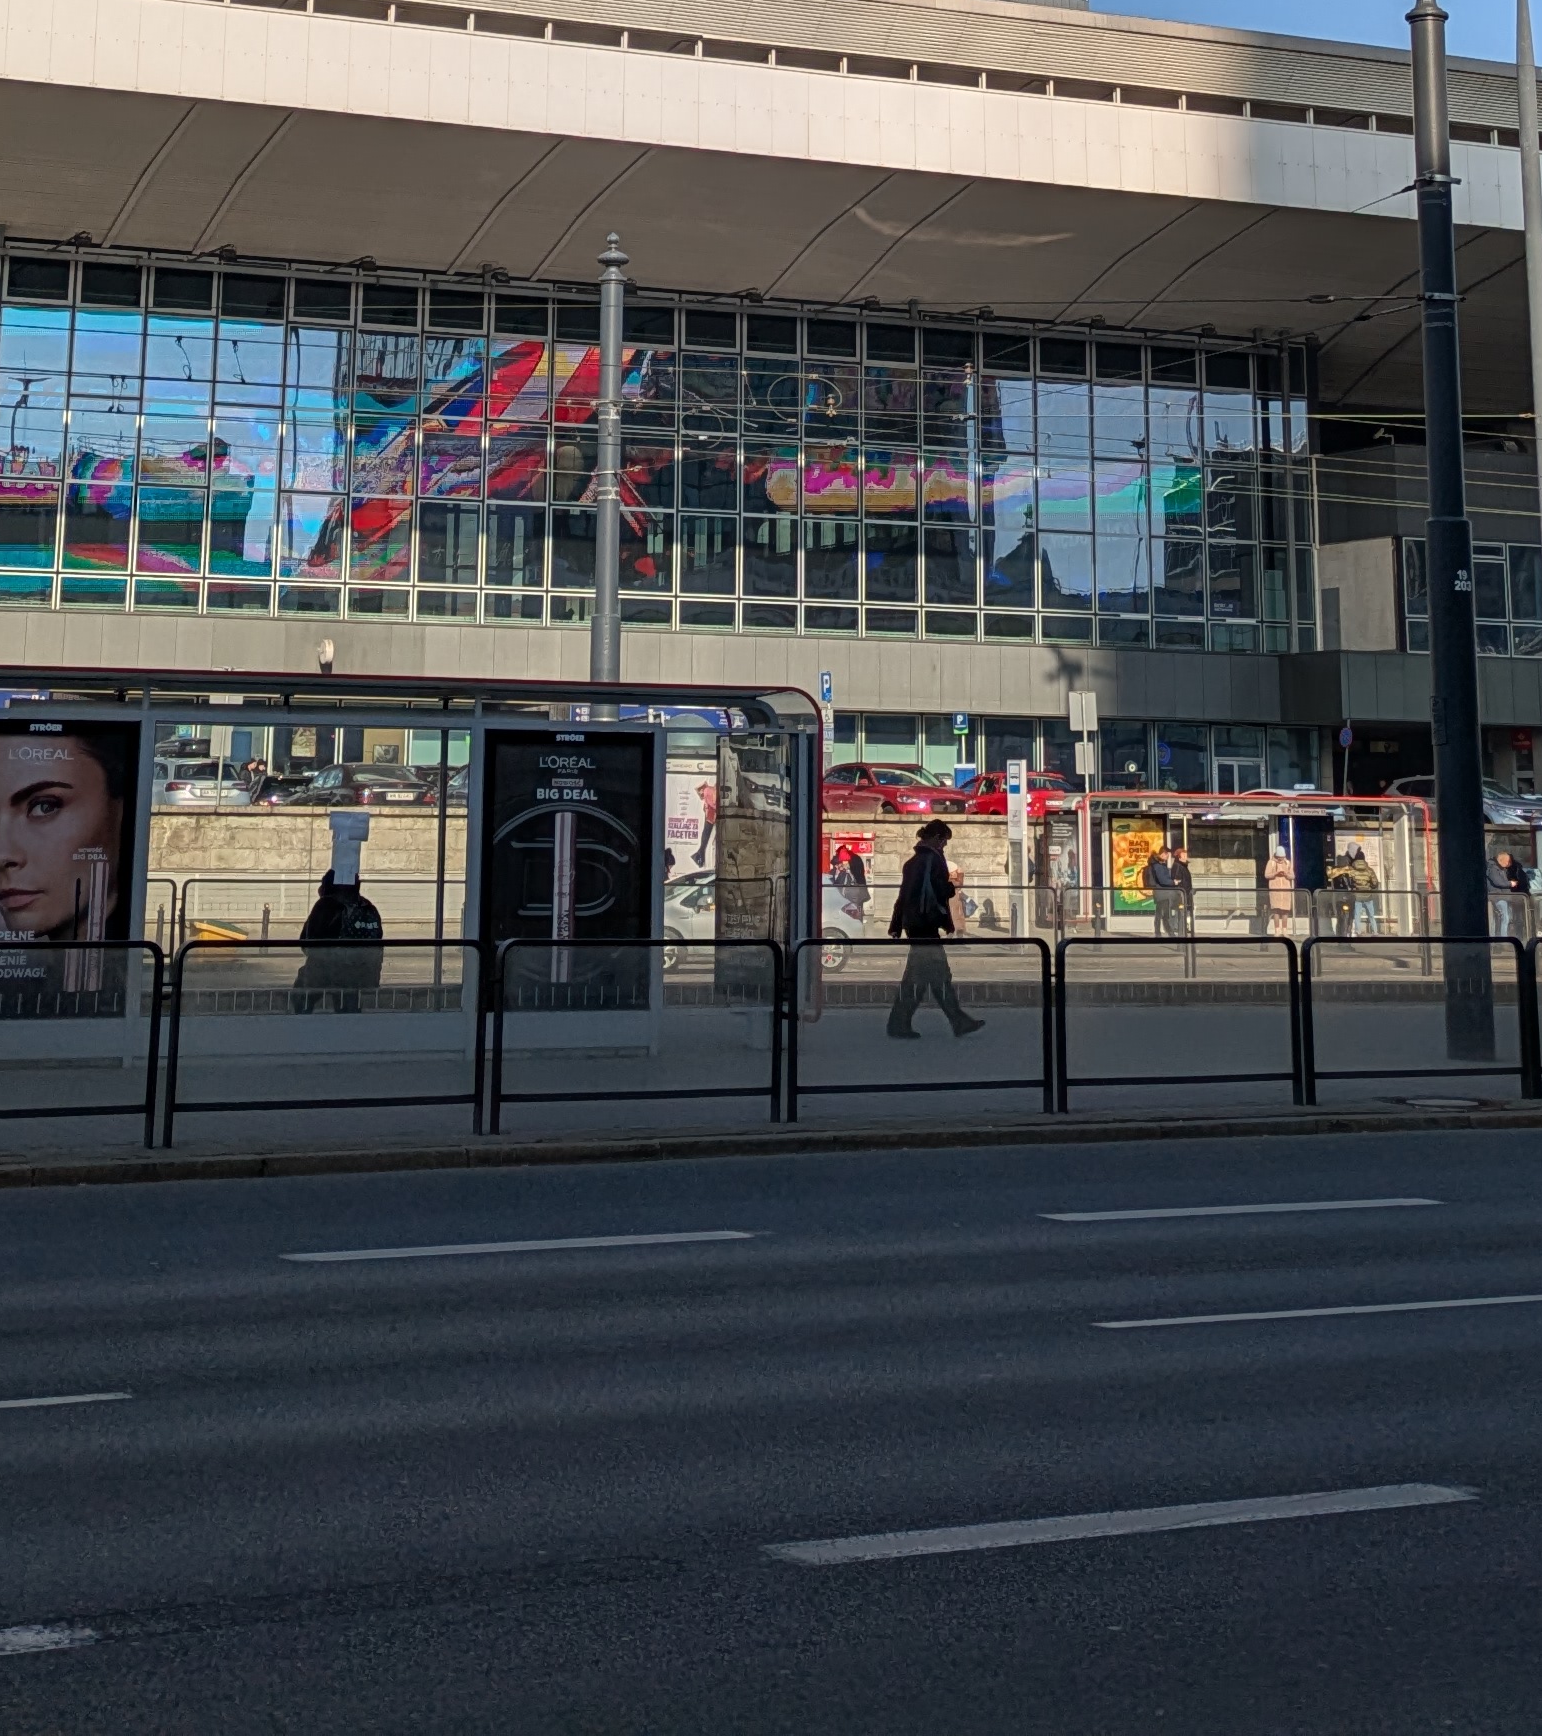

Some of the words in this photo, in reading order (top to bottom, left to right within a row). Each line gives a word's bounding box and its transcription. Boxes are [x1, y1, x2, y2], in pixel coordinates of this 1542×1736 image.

[1457, 569, 1468, 580] 19
[1454, 580, 1472, 591] 203
[823, 674, 831, 694] P
[956, 714, 964, 725] P
[29, 723, 63, 732] STRÖER
[539, 755, 596, 769] L'ORÉAL
[536, 788, 560, 800] BIG
[563, 789, 598, 801] DEAL
[667, 830, 699, 840] FACETEM
[72, 853, 86, 861] BIG
